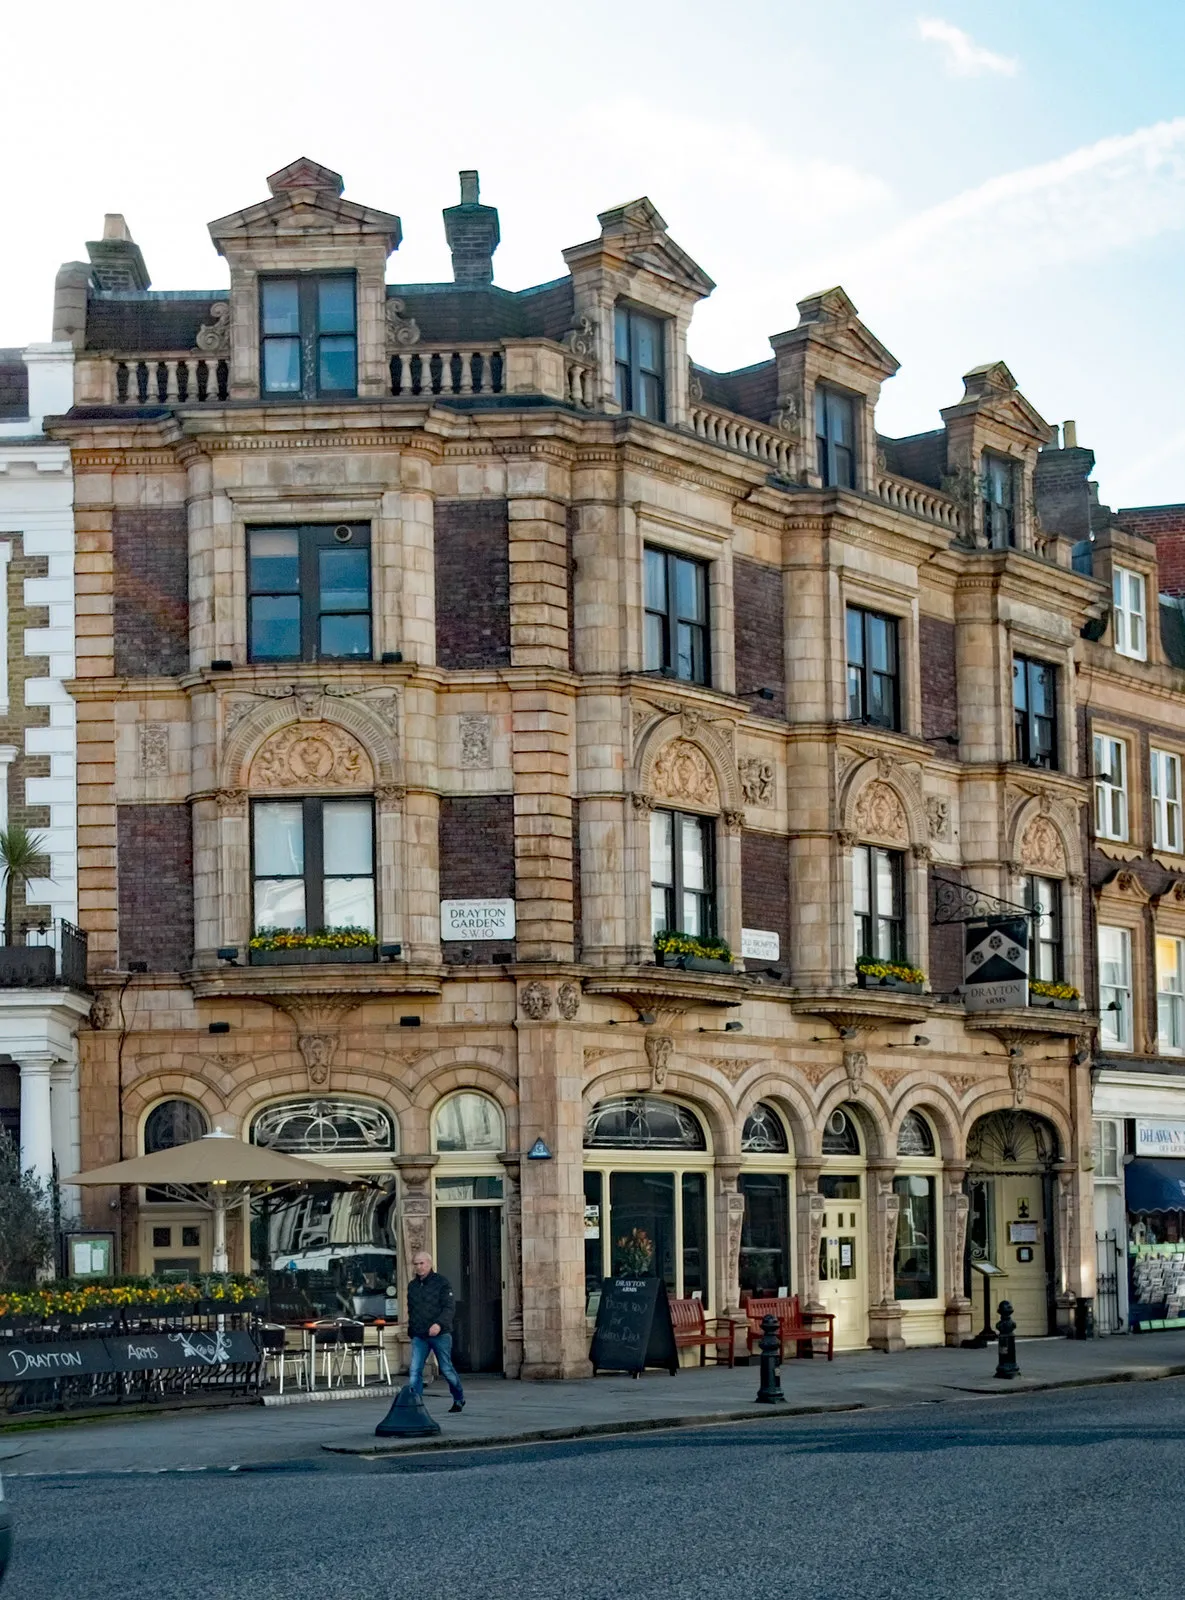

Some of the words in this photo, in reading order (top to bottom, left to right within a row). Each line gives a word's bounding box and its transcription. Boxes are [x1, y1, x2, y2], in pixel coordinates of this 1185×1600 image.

[450, 908, 506, 918] DRAYTON
[451, 919, 505, 929] GARDENS
[970, 984, 1020, 997] DRAYTON
[985, 997, 1007, 1005] ARMS
[8, 1350, 82, 1376] DRAYTON
[128, 1345, 158, 1360] ARMS
